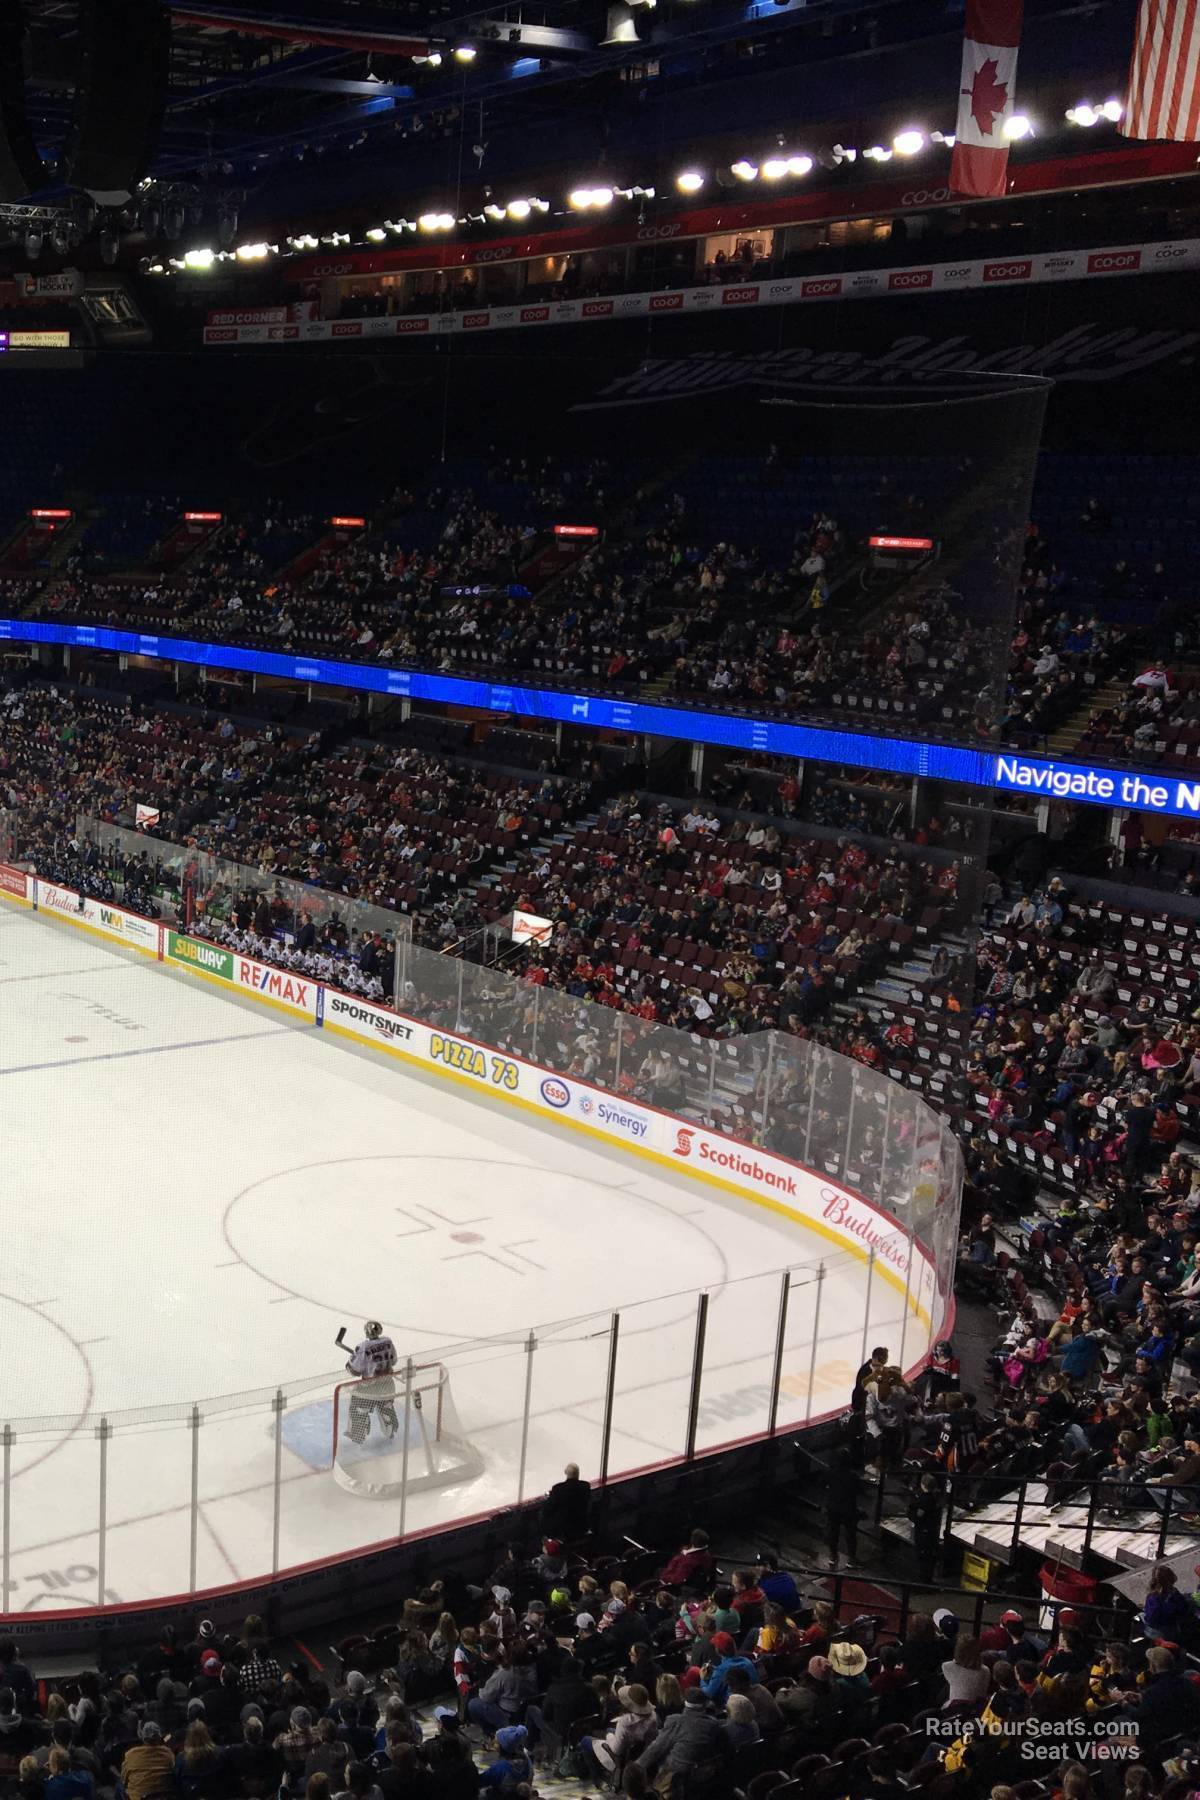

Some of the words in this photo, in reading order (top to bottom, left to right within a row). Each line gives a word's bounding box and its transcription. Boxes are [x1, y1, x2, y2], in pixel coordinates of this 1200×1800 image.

[212, 313, 235, 325] RED
[236, 311, 285, 323] CORNER
[996, 757, 1114, 797] Navigate
[1122, 777, 1168, 807] the
[100, 909, 122, 930] WM
[175, 938, 227, 970] SUBWAY
[240, 961, 307, 1008] RE/MAX
[331, 999, 413, 1040] SPORTSNET
[430, 1034, 486, 1078] PIZZA
[491, 1057, 519, 1090] 73
[545, 1083, 566, 1101] Esso
[598, 1103, 649, 1137] Synergy
[699, 1142, 797, 1196] Scotiabank
[820, 1188, 911, 1273] Budweiser
[940, 1431, 950, 1442] 10
